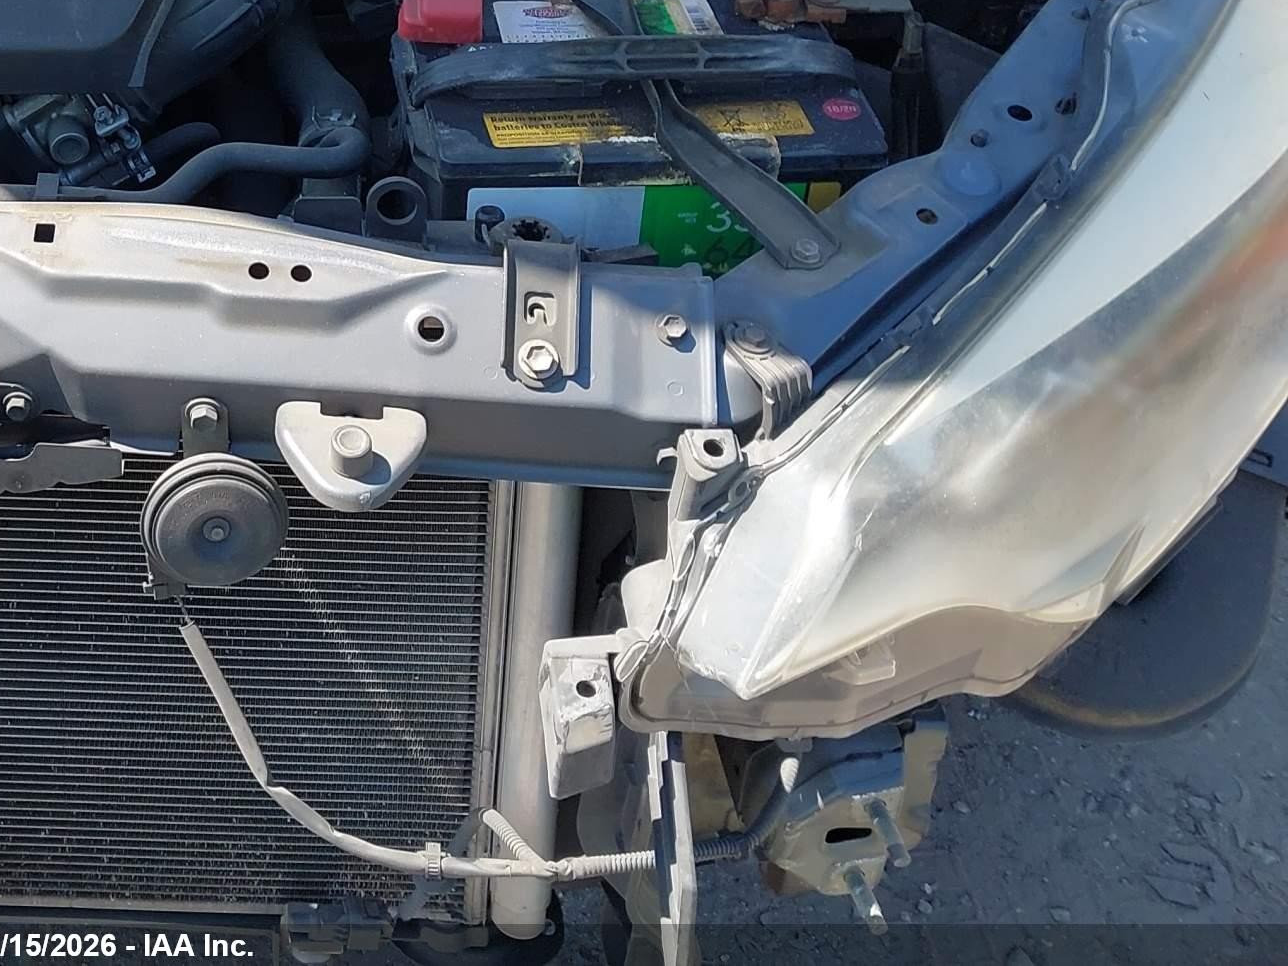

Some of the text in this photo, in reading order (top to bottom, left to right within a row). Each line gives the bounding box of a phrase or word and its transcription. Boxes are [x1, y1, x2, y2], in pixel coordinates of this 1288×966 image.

[490, 115, 526, 124] Return
[528, 113, 574, 123] warranty
[577, 112, 596, 120] and
[493, 122, 539, 132] batteries
[541, 122, 553, 130] to
